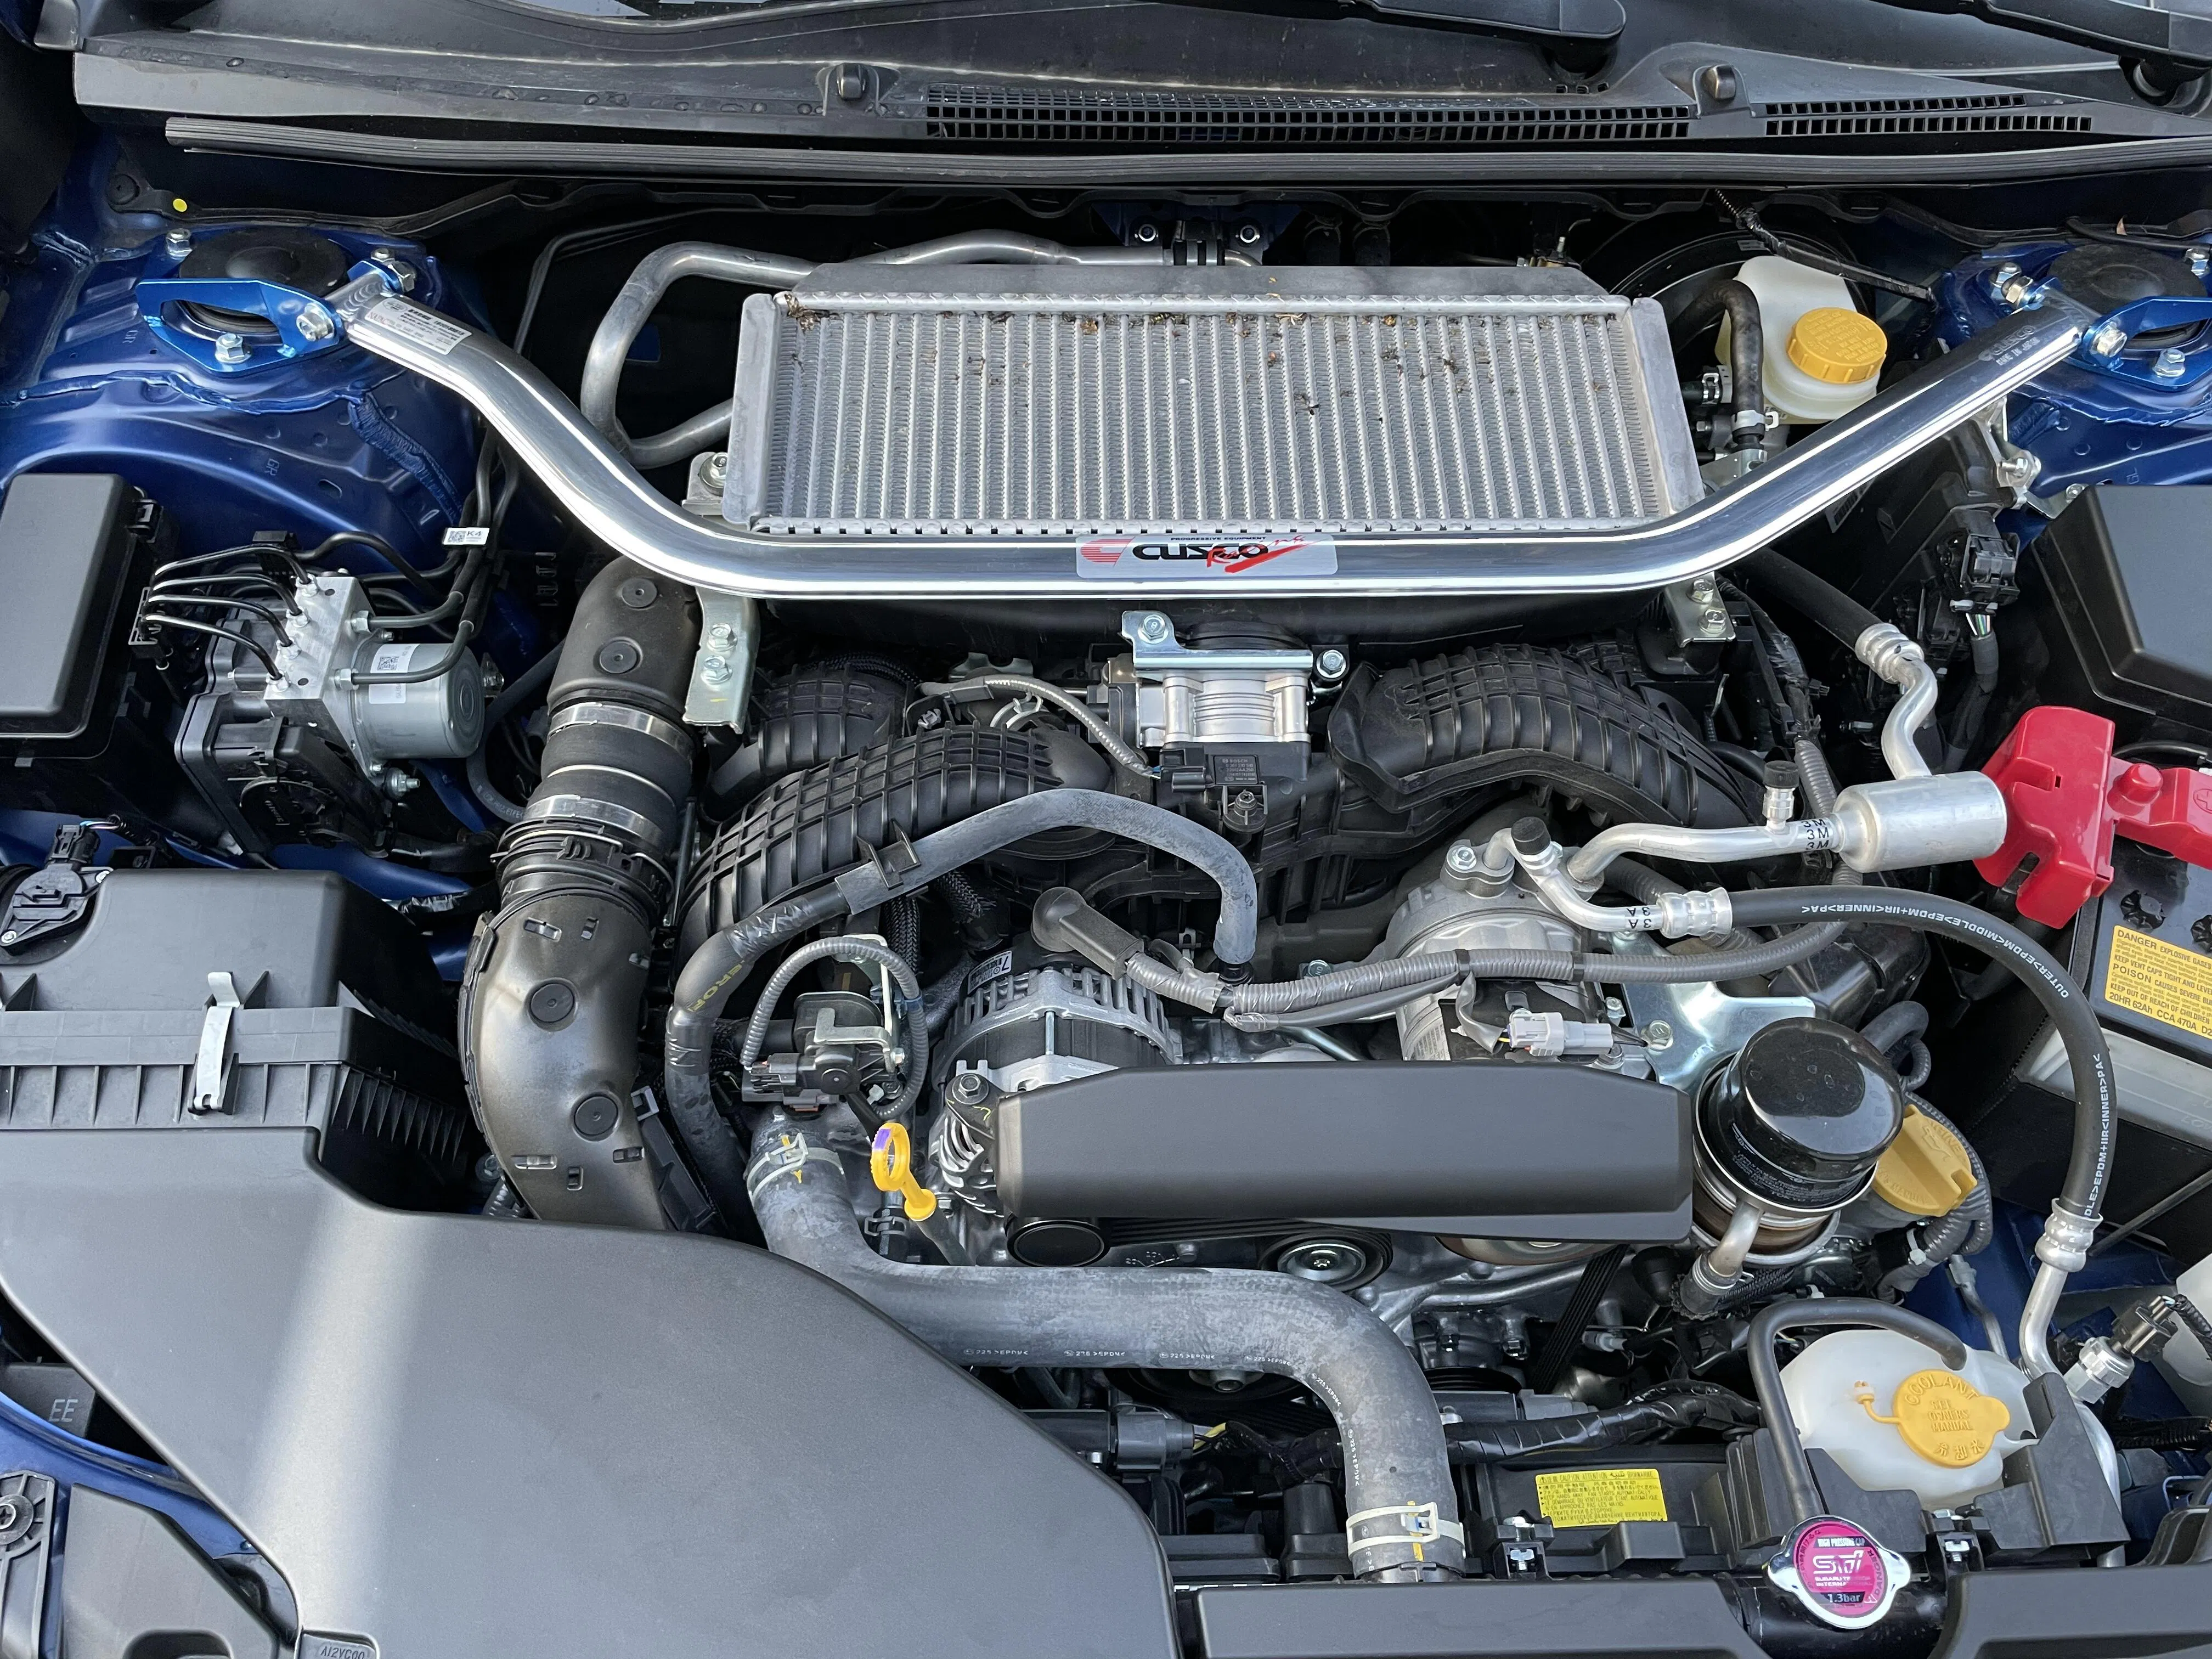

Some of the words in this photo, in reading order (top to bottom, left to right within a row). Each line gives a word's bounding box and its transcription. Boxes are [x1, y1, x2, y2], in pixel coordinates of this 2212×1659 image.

[2118, 929, 2157, 950] DANGER
[2160, 946, 2191, 962] EXPLOSIVE
[2113, 963, 2152, 983] POISON
[2154, 979, 2177, 993] CAUSES
[2179, 989, 2201, 1002] SEVERE
[2114, 954, 2130, 963] KEEP
[2131, 960, 2146, 970] VENT
[2147, 966, 2163, 977] CAPS
[2164, 971, 2181, 983] TIGHT
[2182, 979, 2195, 989] AND
[2109, 991, 2131, 1006] 20HR
[2132, 1000, 2153, 1014] 62Ah
[2157, 1009, 2175, 1023] CCA
[2176, 1017, 2197, 1031] 470A
[2126, 988, 2138, 998] OUT
[2140, 993, 2148, 1001] OF
[2149, 997, 2170, 1009] REACH
[2171, 1005, 2179, 1013] OF
[2180, 1008, 2210, 1025] CHILDREN
[1904, 1373, 1979, 1406] COOLANT
[48, 1399, 78, 1423] EE
[1867, 1550, 1884, 1596] DANGER
[1827, 1593, 1861, 1603] 1.3bar
